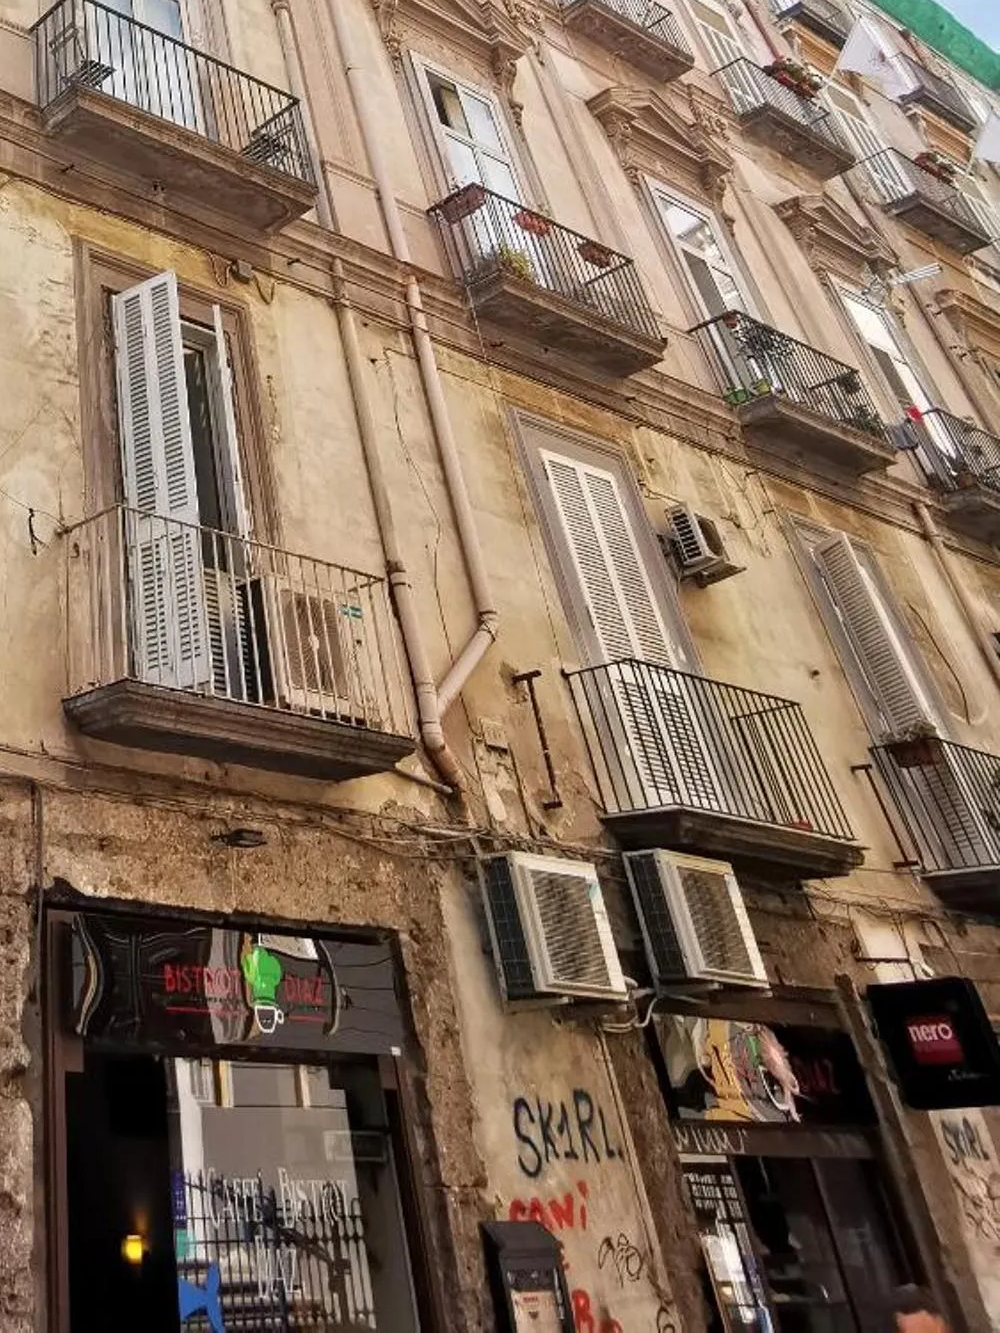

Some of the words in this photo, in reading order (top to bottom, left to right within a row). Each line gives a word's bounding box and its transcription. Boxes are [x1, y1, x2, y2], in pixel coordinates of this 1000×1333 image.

[163, 963, 241, 995] BISTROT
[284, 973, 325, 1005] DIAZ
[908, 1023, 953, 1042] nero
